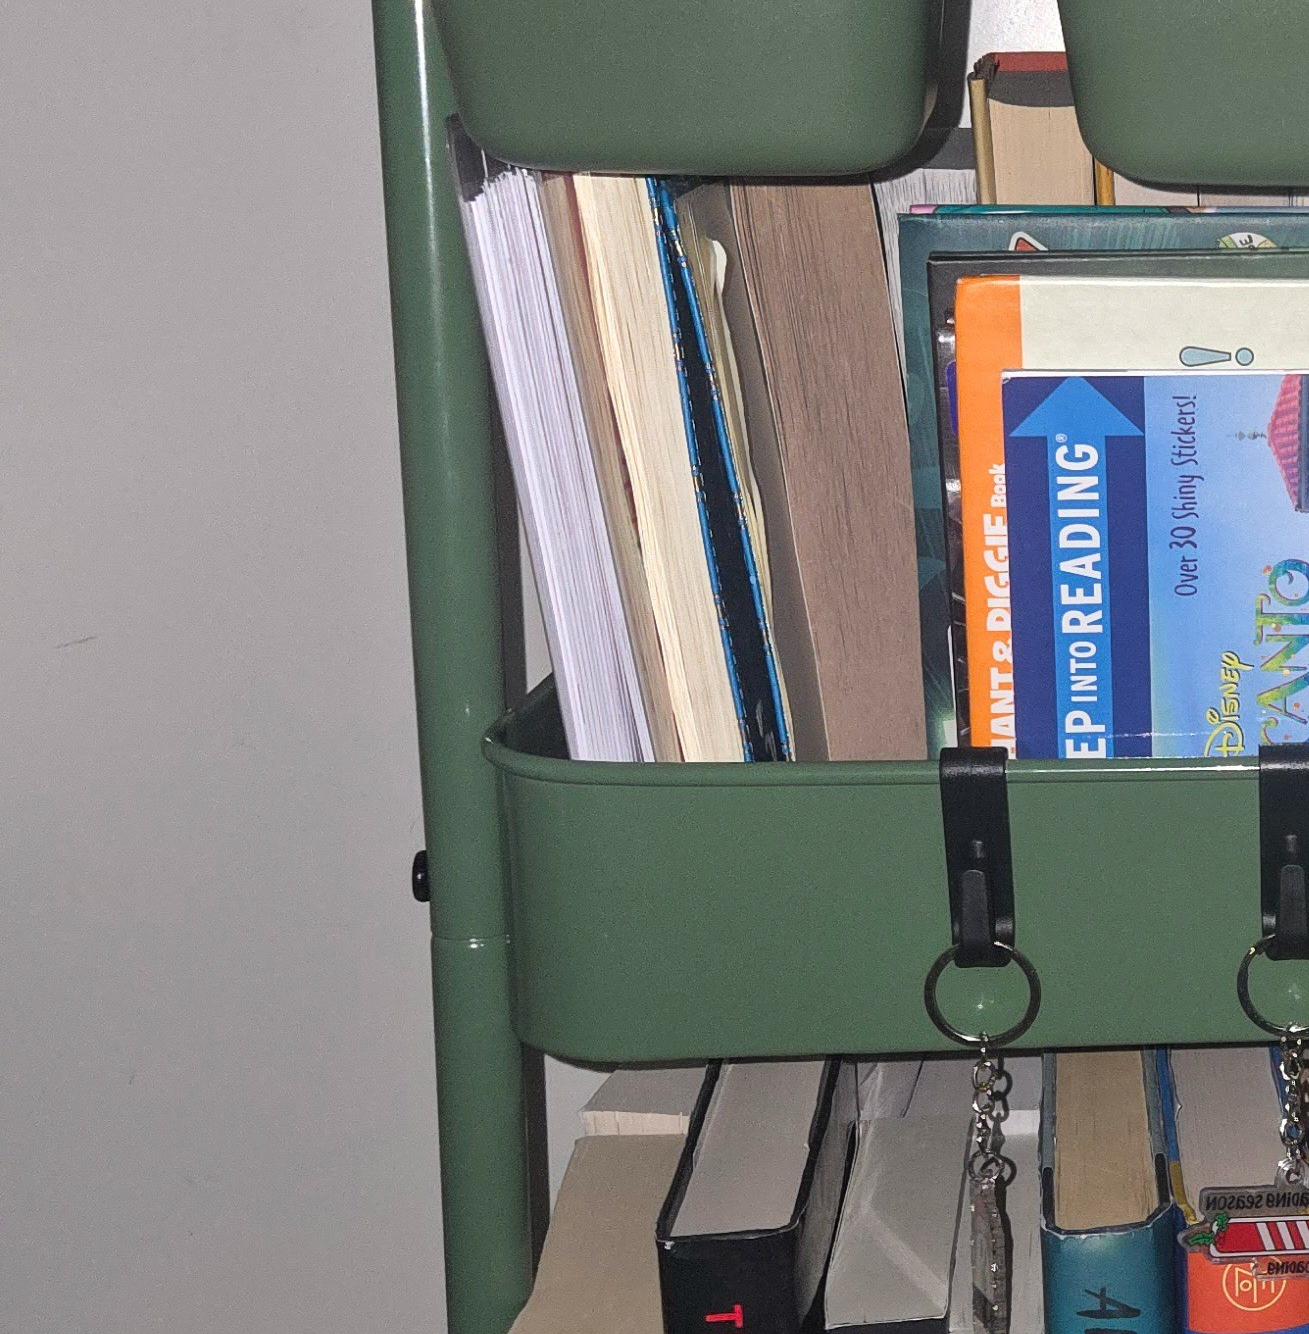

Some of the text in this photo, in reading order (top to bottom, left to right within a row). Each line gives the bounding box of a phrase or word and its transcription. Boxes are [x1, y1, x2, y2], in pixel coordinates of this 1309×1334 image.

[989, 463, 1006, 508] Book
[1171, 394, 1203, 596] Over 30 Shiny Stickers!
[1071, 636, 1098, 701] INTO
